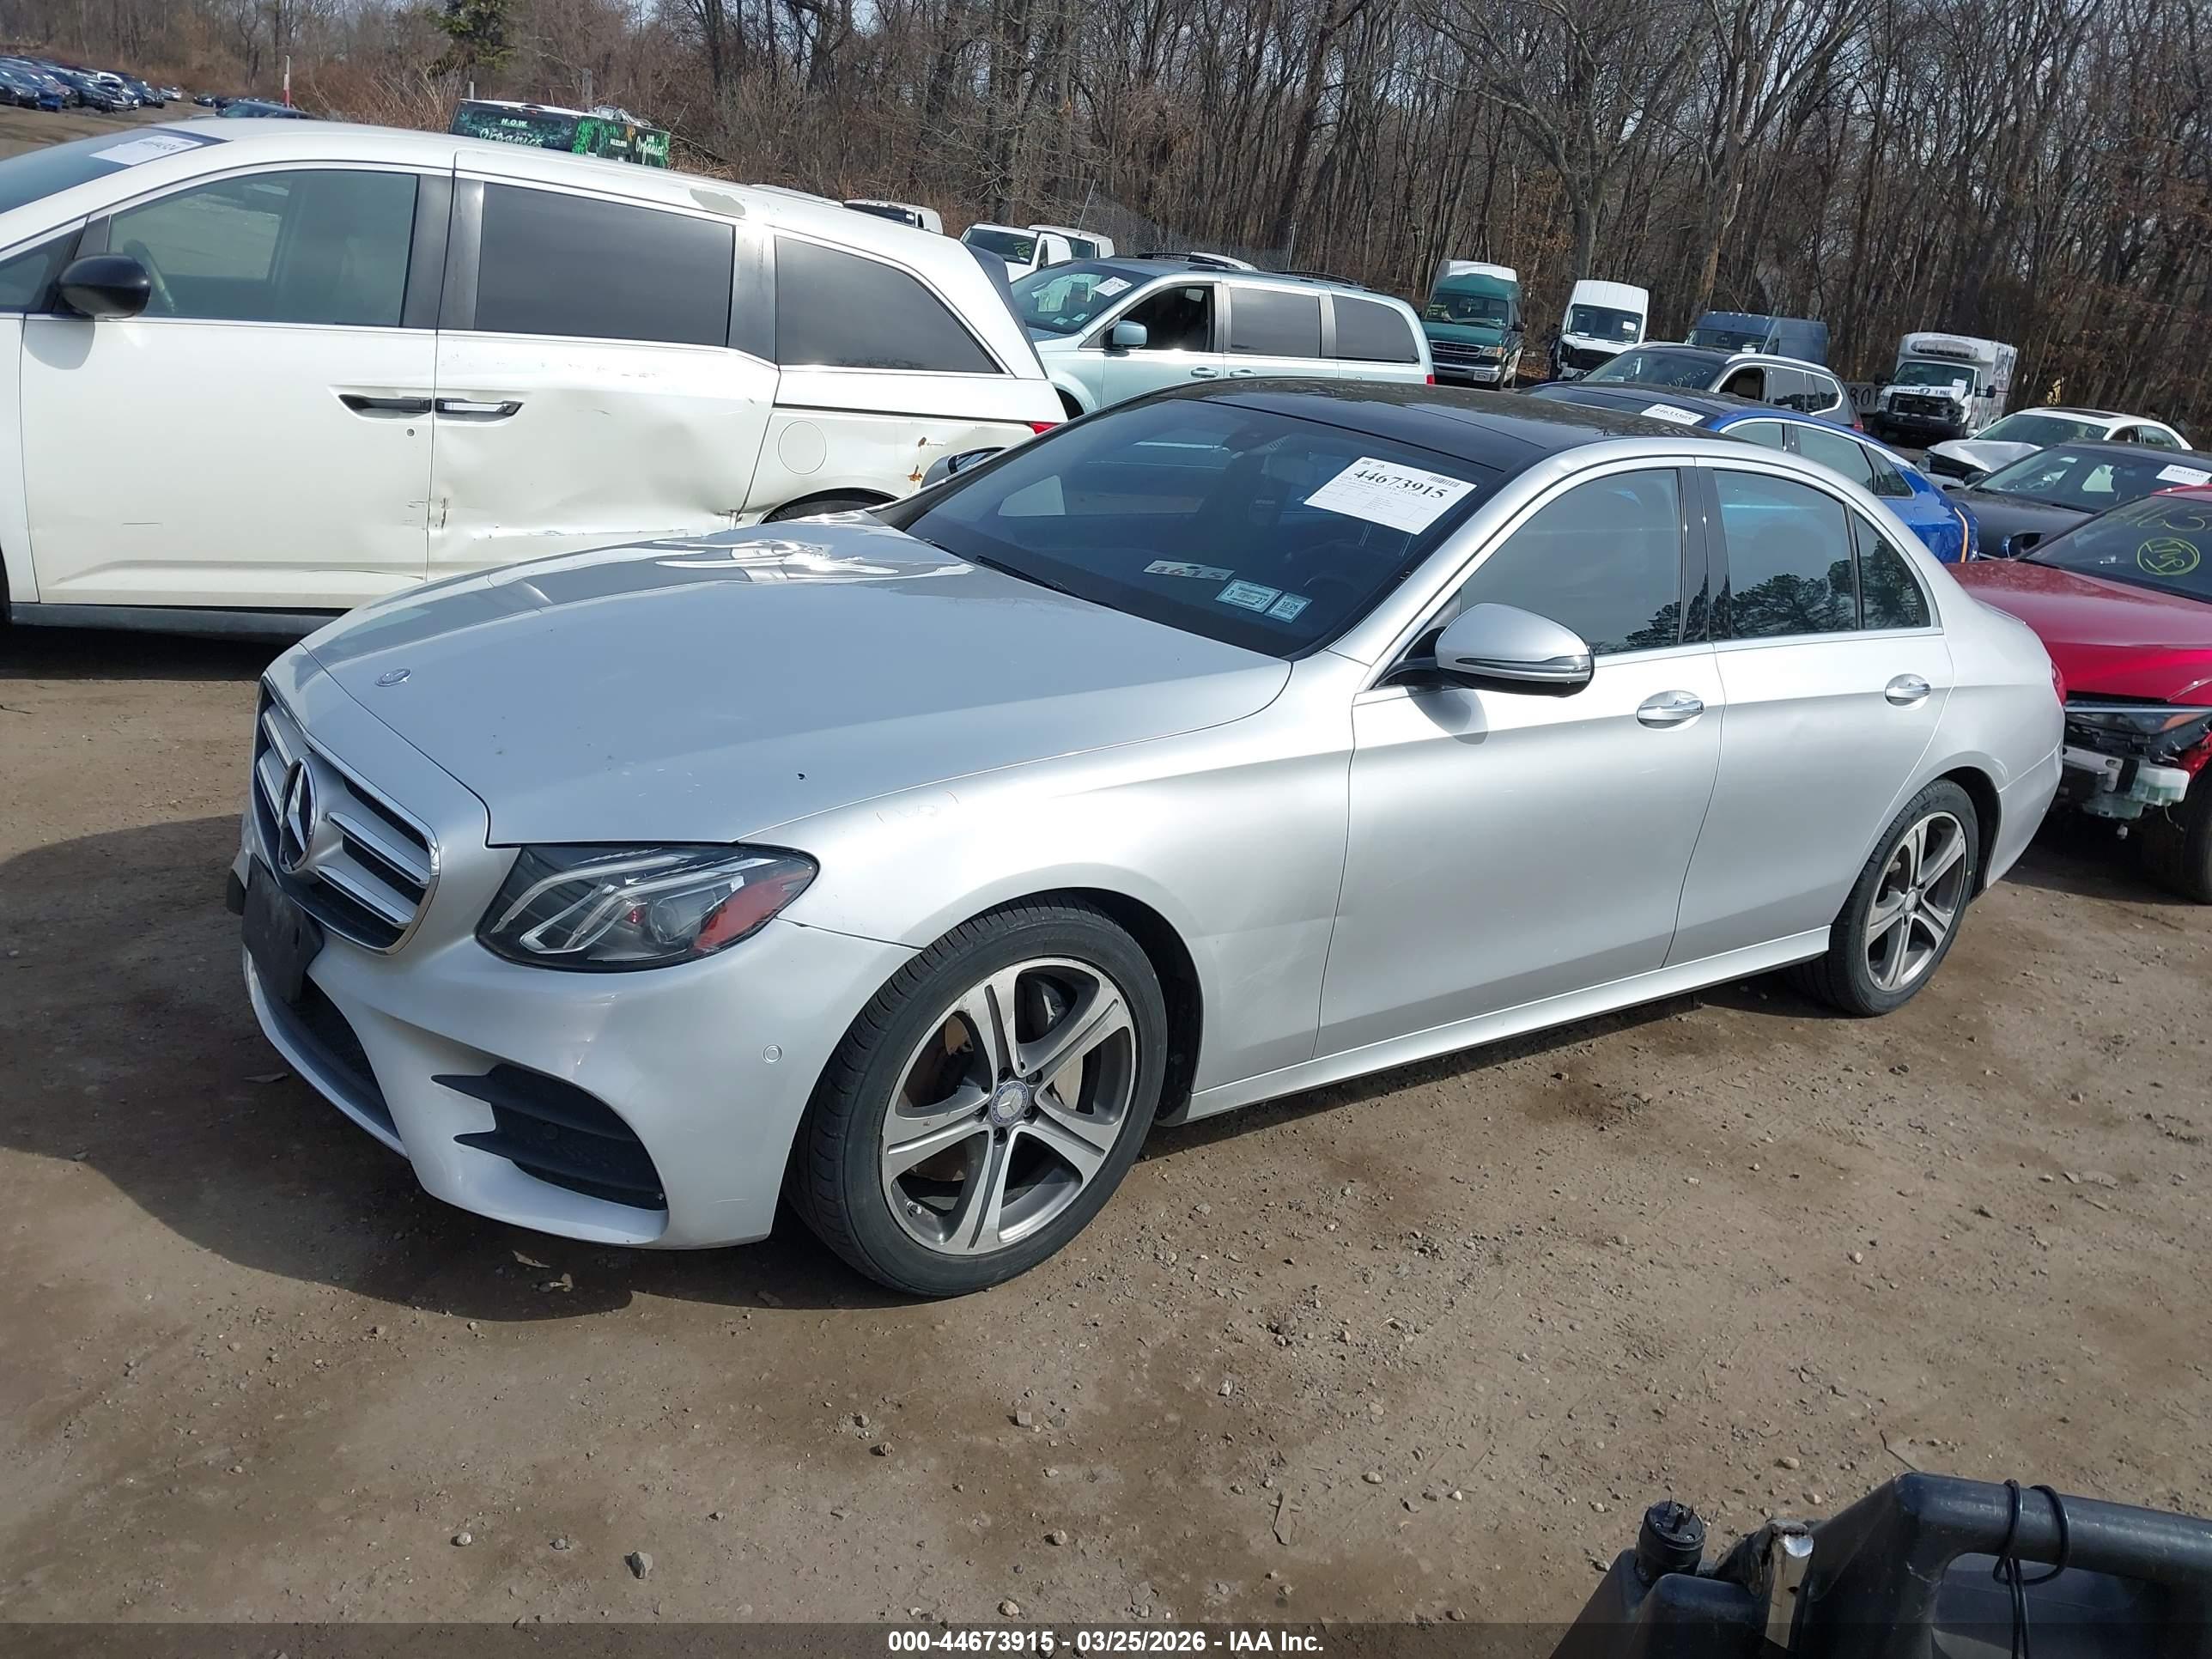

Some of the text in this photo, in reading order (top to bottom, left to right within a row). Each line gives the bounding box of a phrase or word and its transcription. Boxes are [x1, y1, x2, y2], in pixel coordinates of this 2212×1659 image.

[635, 136, 664, 165] Organics
[1353, 470, 1448, 499] 44673915
[1152, 566, 1224, 579] 4615
